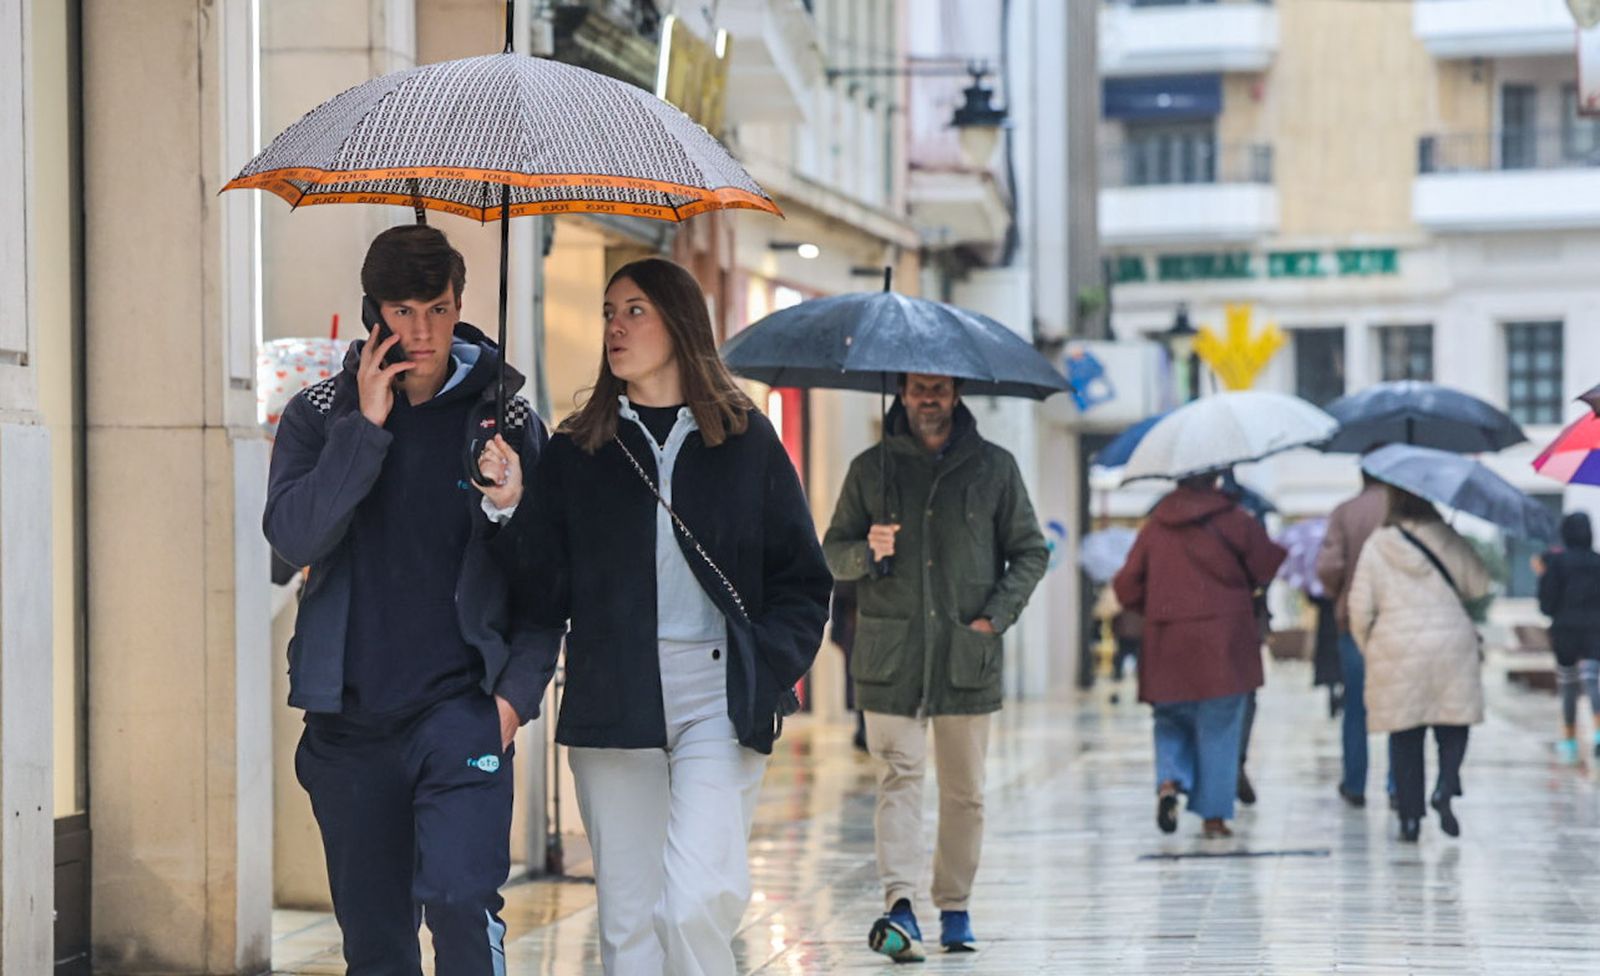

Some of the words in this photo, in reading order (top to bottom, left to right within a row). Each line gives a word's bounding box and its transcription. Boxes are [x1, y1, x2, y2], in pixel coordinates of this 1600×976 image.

[336, 174, 369, 182] TOUS
[386, 170, 417, 178] TOUS
[435, 169, 465, 178] TOUS
[482, 173, 512, 182] TOUS
[540, 177, 568, 186] TOUS
[583, 177, 612, 186] TOUS
